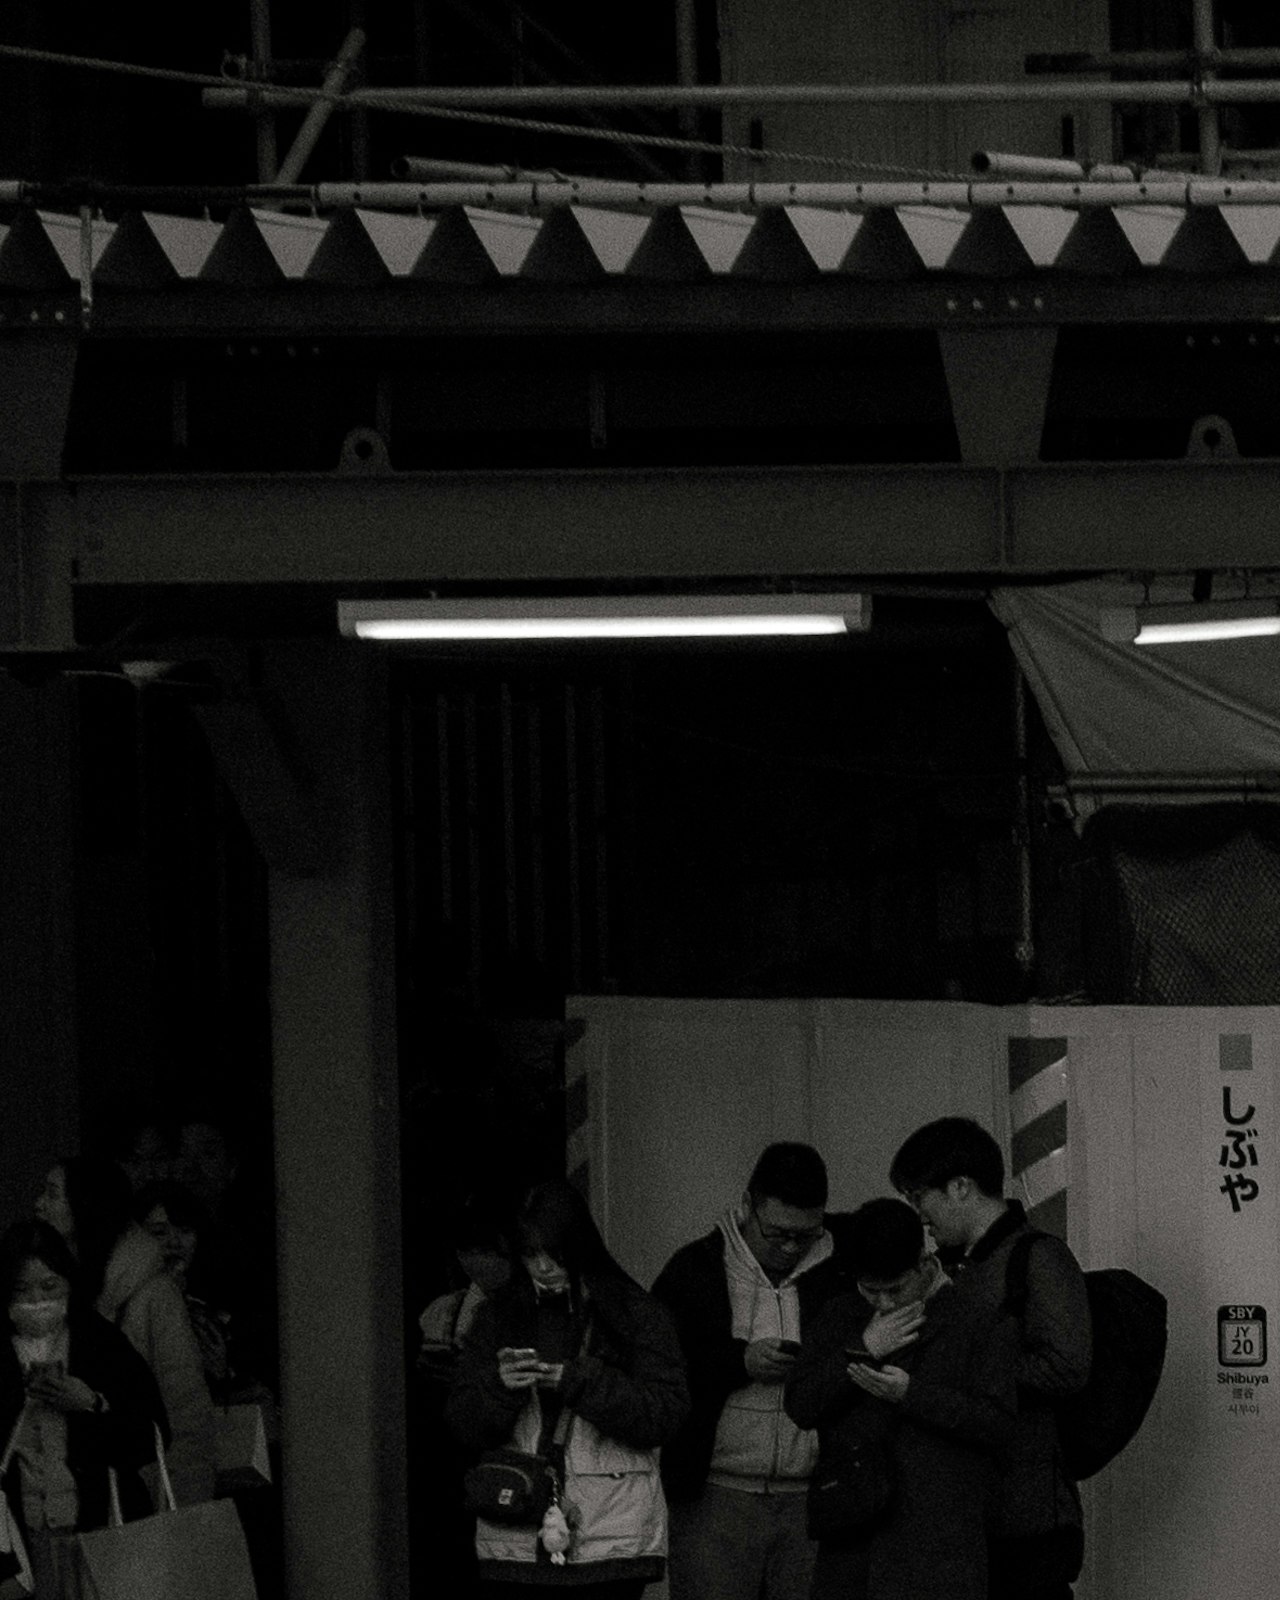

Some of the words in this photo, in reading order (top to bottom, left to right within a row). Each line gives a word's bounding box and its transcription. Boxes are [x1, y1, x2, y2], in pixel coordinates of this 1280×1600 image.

[1218, 1085, 1260, 1214] しぶや
[1227, 1306, 1256, 1320] SBY
[1234, 1326, 1251, 1339] JY
[1231, 1339, 1254, 1356] 20
[1216, 1372, 1270, 1386] Shibuya
